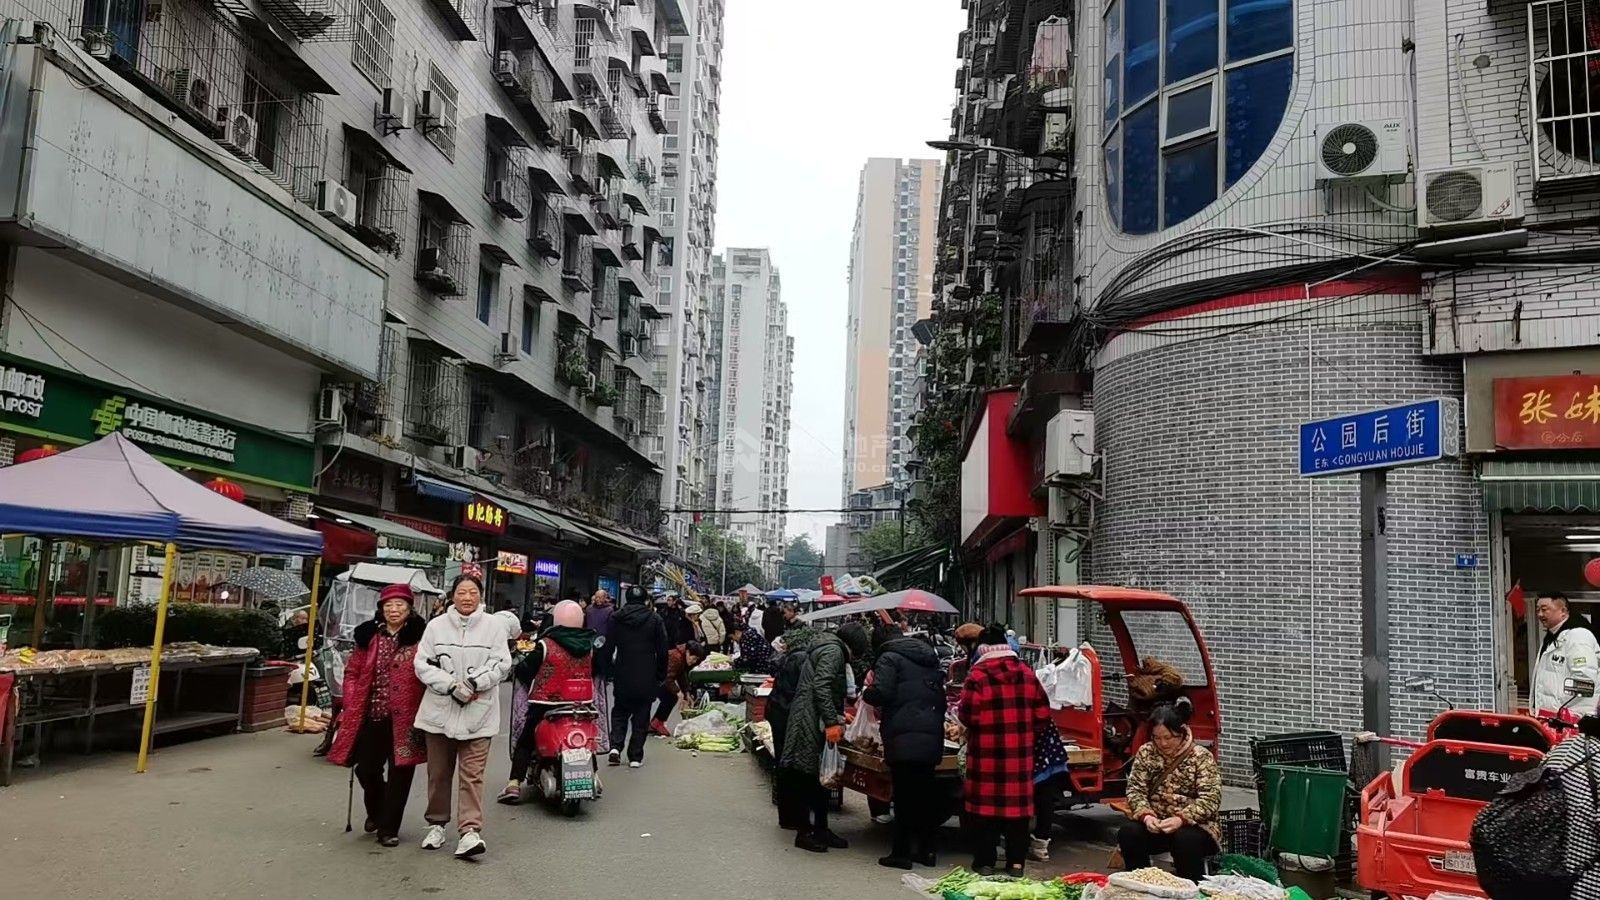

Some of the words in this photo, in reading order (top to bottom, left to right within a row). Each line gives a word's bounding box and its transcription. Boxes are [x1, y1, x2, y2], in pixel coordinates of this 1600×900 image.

[6, 396, 43, 418] POST
[124, 402, 236, 449] 中国邮政储蓄银行
[1311, 409, 1426, 453] 公园后街
[124, 428, 155, 444] POSTAL
[157, 435, 186, 450] SAVINGS
[1390, 442, 1425, 458] HOUJIE
[1464, 768, 1512, 783] 富贵车业
